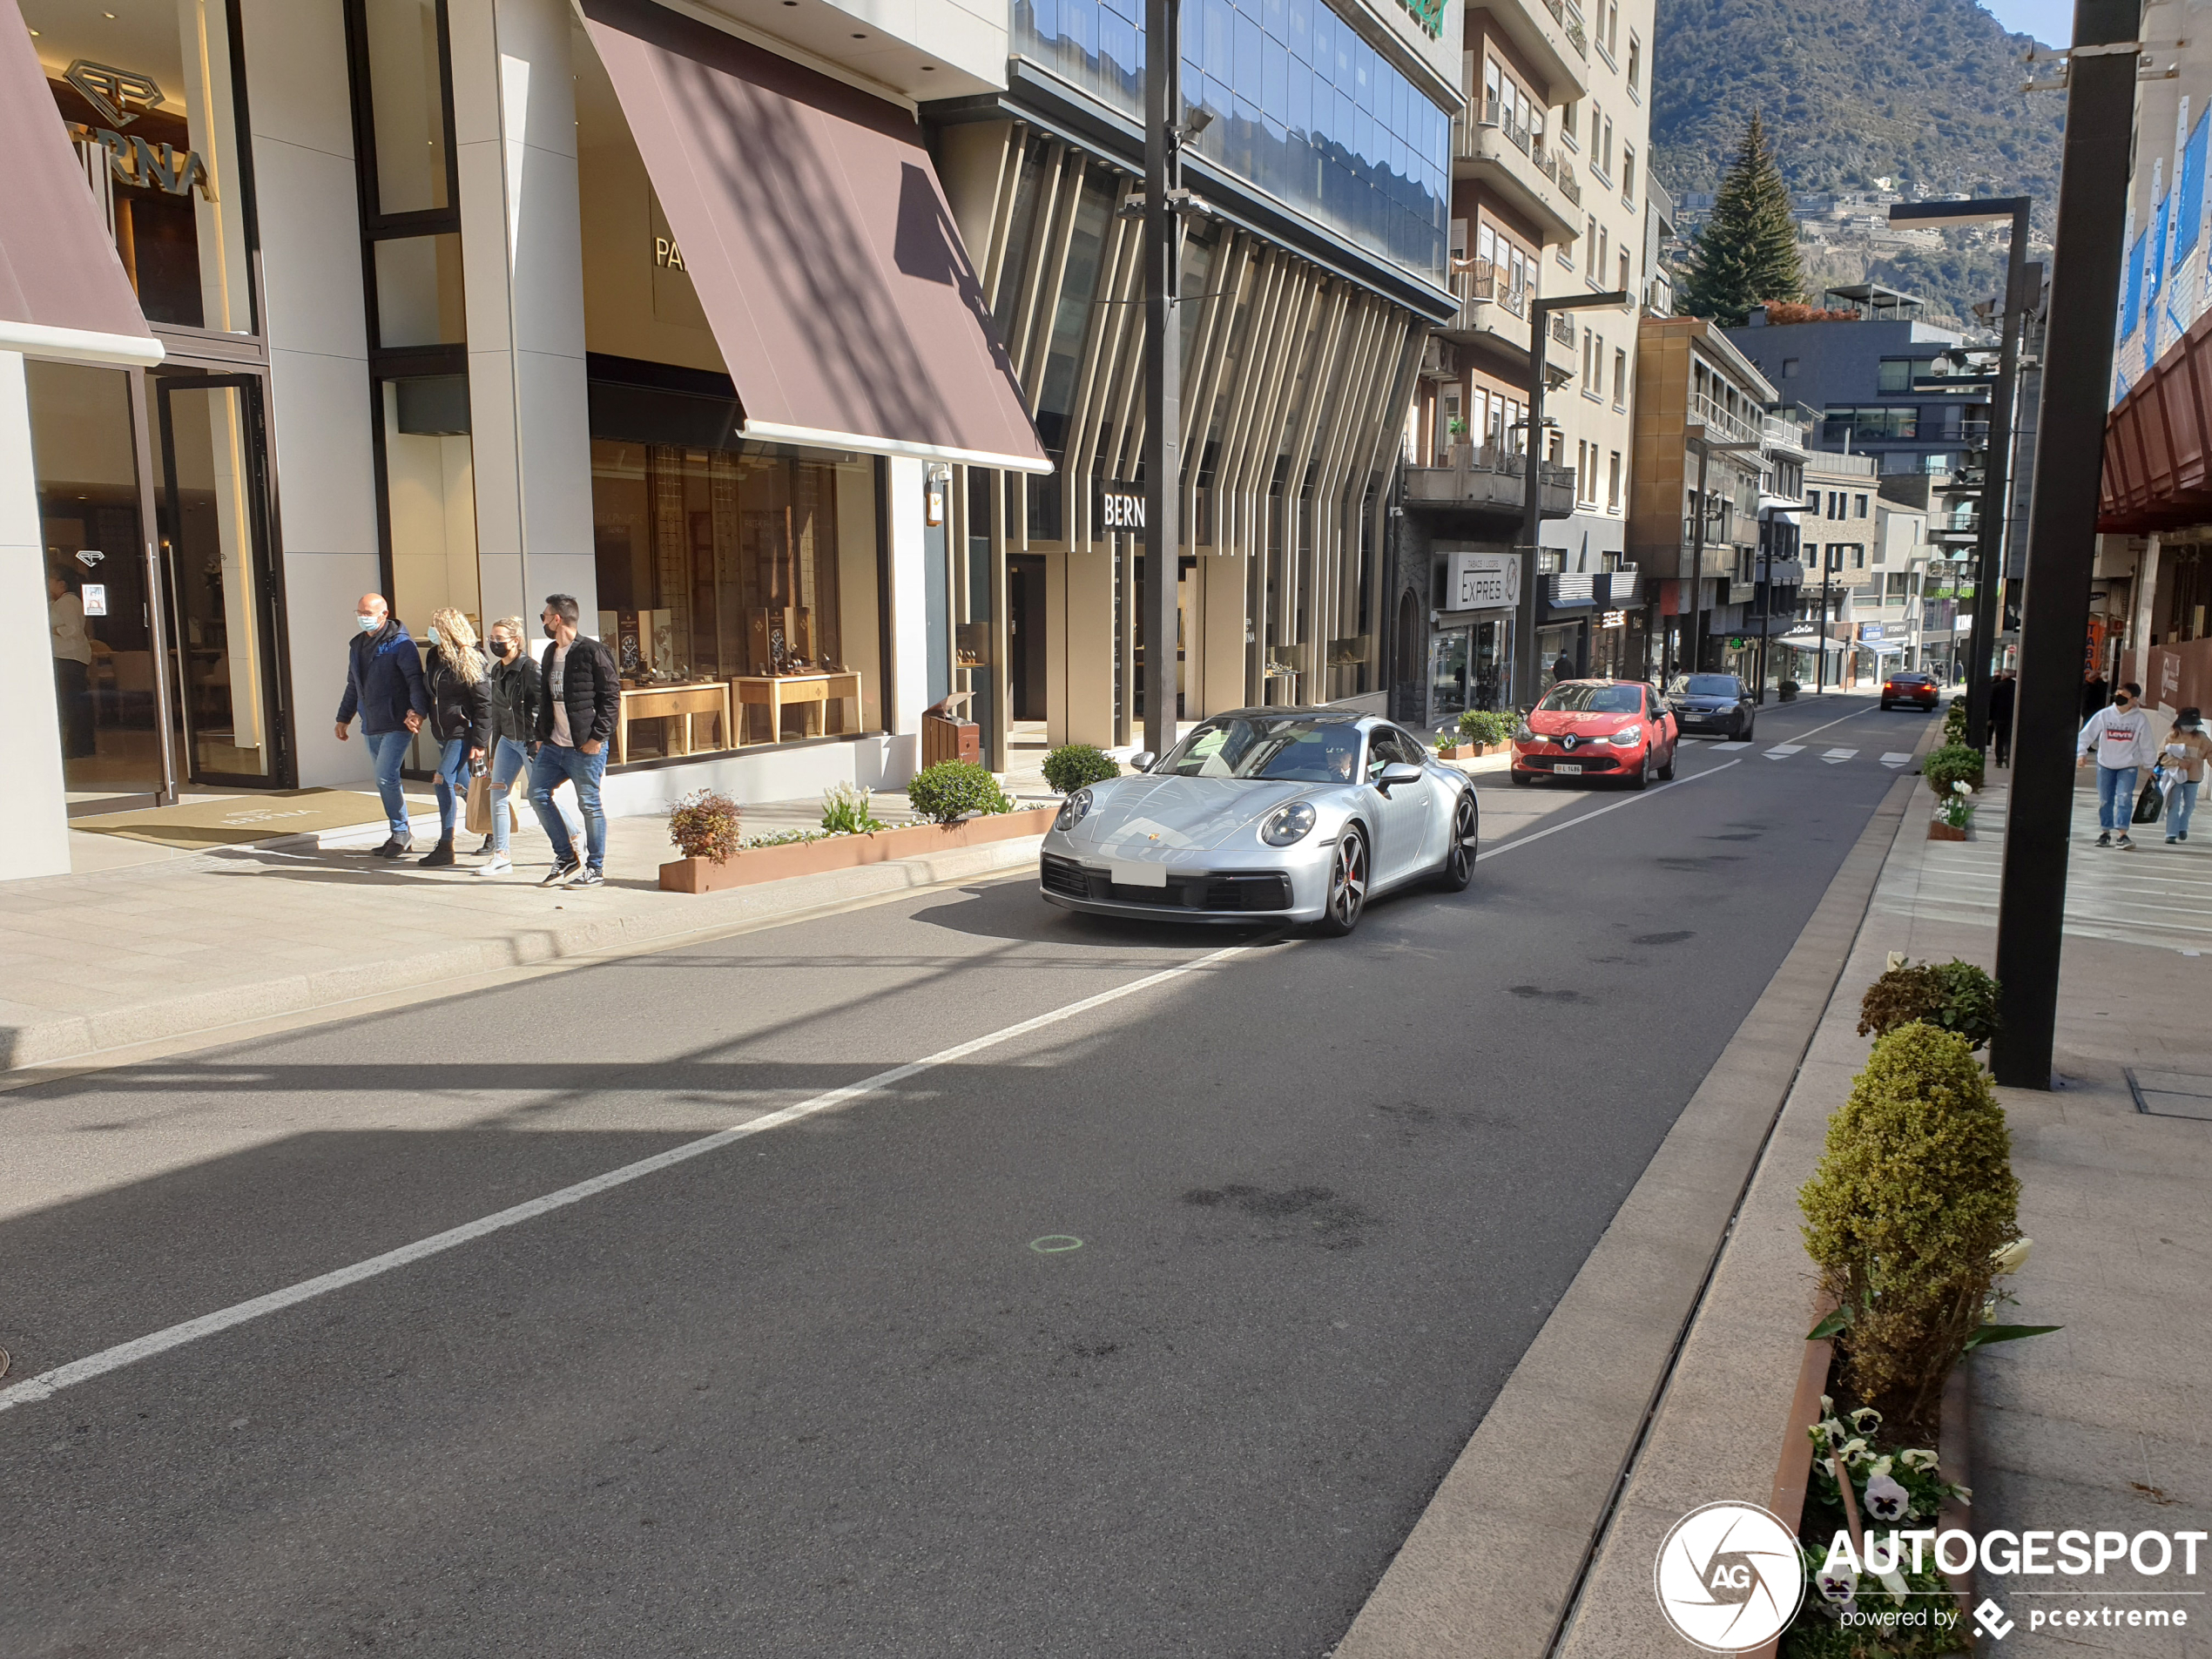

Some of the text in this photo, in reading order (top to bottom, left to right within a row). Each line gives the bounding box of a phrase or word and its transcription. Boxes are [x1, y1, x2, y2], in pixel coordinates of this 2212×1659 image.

[655, 236, 687, 273] PA
[1104, 493, 1145, 528] BERN
[1462, 570, 1501, 602] EXPRÉS
